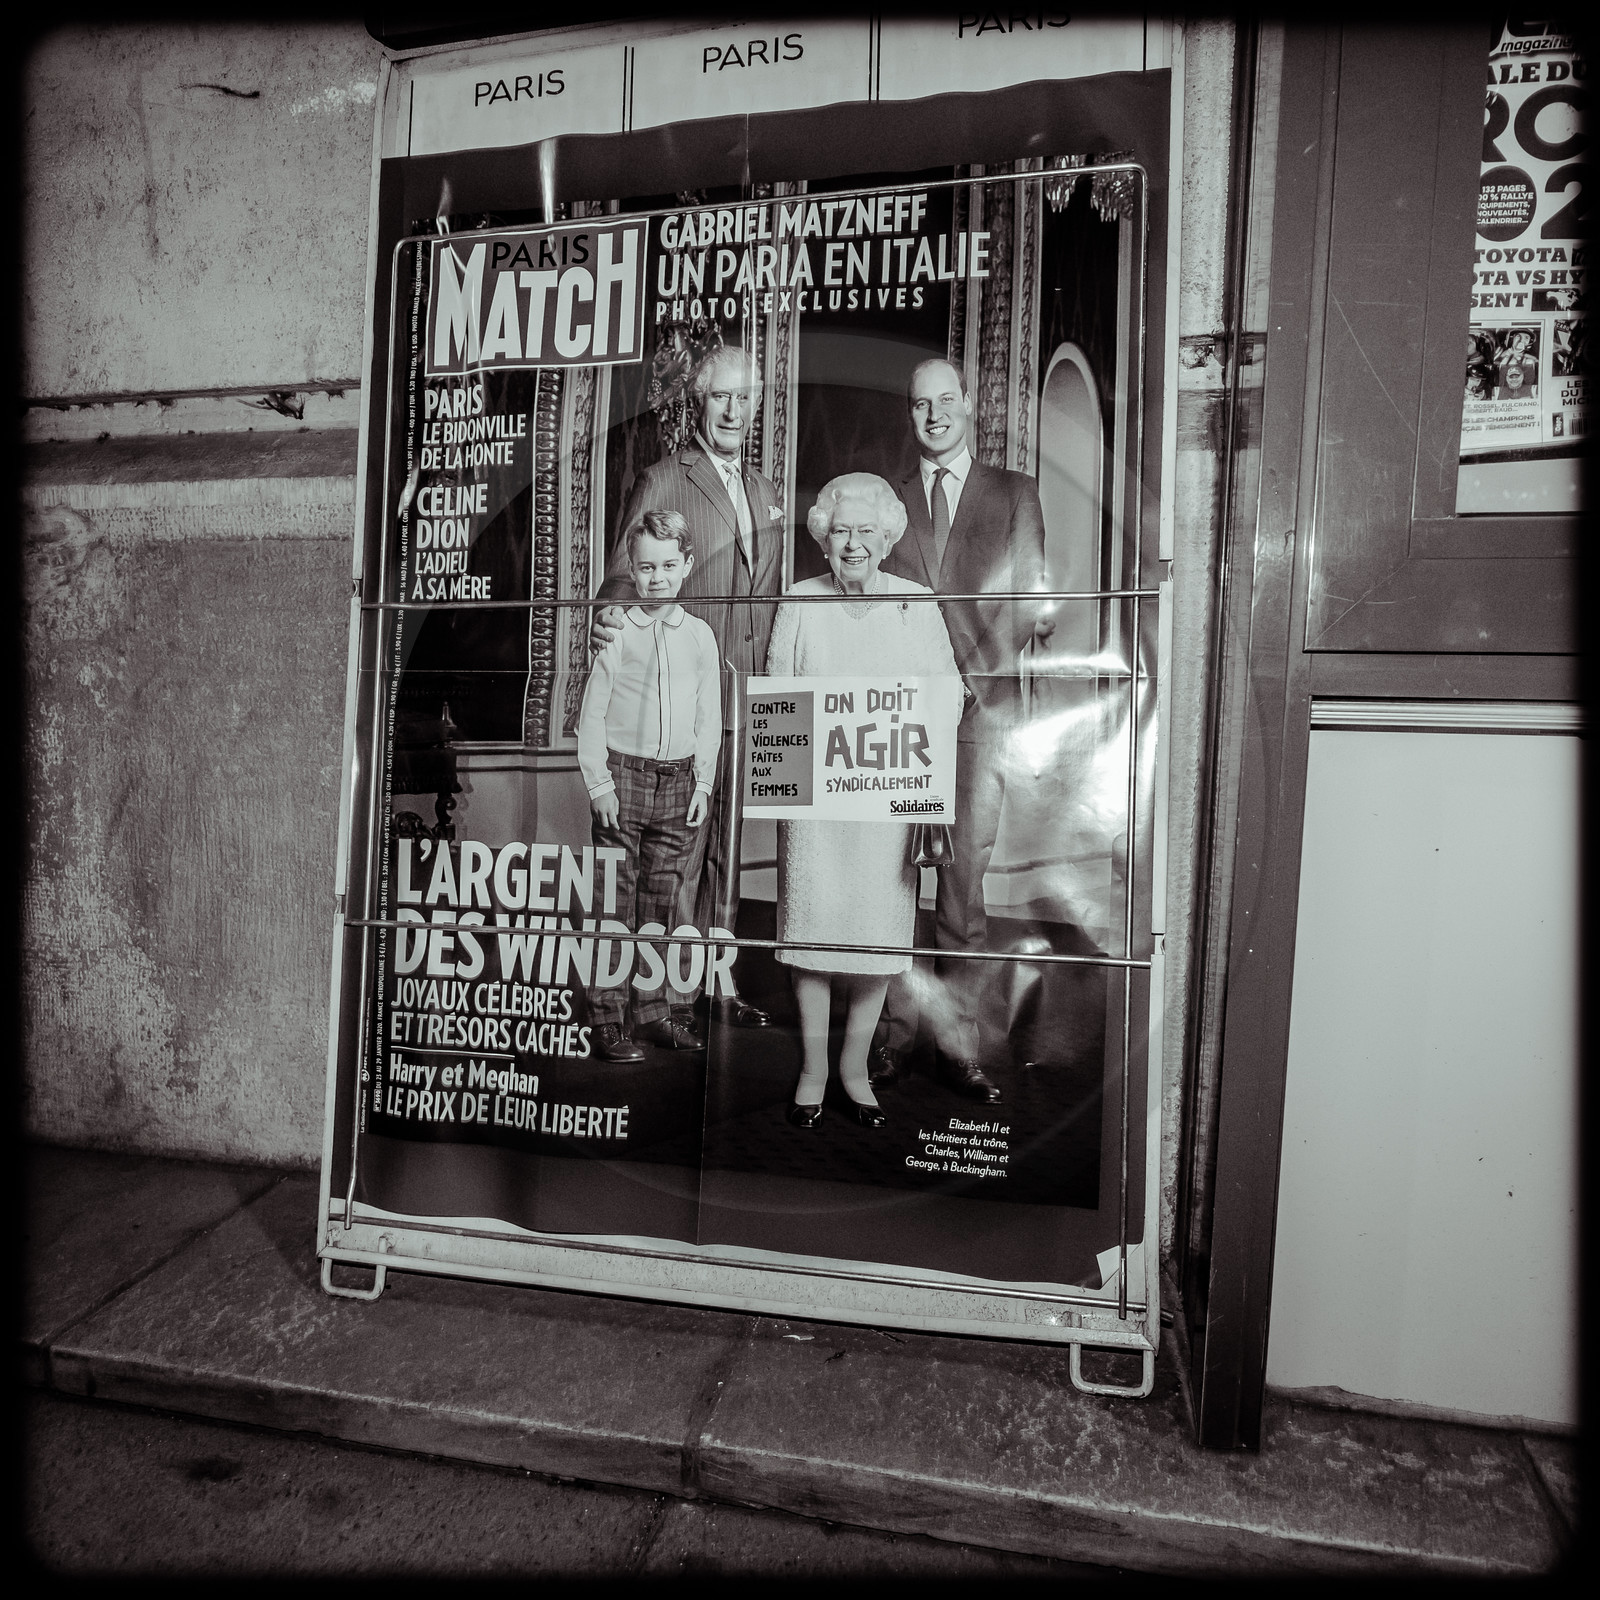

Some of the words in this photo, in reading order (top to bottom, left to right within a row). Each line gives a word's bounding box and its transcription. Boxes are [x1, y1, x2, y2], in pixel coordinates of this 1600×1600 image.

[958, 10, 1072, 39] PARIS
[703, 33, 804, 73] PARIS
[474, 70, 566, 107] PARIS
[1482, 184, 1496, 194] 132
[1497, 184, 1527, 193] PAGES
[1500, 191, 1534, 201] RALLYE
[660, 206, 771, 250] GABRIEL
[778, 193, 928, 242] MATZNEFF
[491, 235, 589, 269] PARIS
[657, 252, 707, 298] UN
[715, 243, 816, 293] PARIA
[825, 239, 871, 285] EN
[881, 231, 991, 283] ITALIE
[1515, 270, 1546, 286] VS
[433, 229, 640, 368] MATCH
[656, 297, 750, 322] PHOTOS
[763, 286, 925, 313] EXCLUSIVES
[424, 384, 483, 419] PARIS
[422, 422, 441, 444] LE
[443, 413, 527, 444] BIDONVILLE
[1487, 414, 1535, 423] CHAMPIONS
[420, 447, 441, 470] DE
[444, 446, 464, 470] LA
[465, 441, 514, 468] HONTE
[416, 483, 488, 517] CÉLINE
[416, 518, 470, 549] DION
[414, 550, 468, 575] L'ADIEU
[411, 574, 424, 600] À
[426, 577, 447, 600] SA
[449, 571, 492, 600] MÈRE
[376, 1065, 382, 1073] AU
[412, 297, 420, 314] RANALD
[751, 701, 796, 715] CONTRE
[824, 691, 854, 714] ON
[752, 719, 768, 729] LES
[751, 732, 809, 748] VIOLENCES
[824, 714, 933, 771] AGIR
[751, 750, 783, 764] FAITES
[751, 766, 772, 777] AUX
[751, 781, 798, 797] FEMMES
[826, 773, 933, 794] SYNDICALEMENT
[890, 800, 945, 815] Solidaires
[397, 838, 627, 915] L'ARGENT
[394, 907, 487, 980] DES
[496, 913, 739, 998] WINDSOR
[390, 977, 471, 1014] JOYAUX
[473, 980, 574, 1022] CÉLÈBRES
[390, 1011, 418, 1043] ET
[416, 1011, 511, 1051] TRÉSORS
[514, 1020, 593, 1059] CACHÉS
[389, 1053, 438, 1087] Harry
[440, 1062, 465, 1085] et
[467, 1060, 540, 1097] Meghan
[386, 1085, 402, 1116] LE
[405, 1088, 457, 1122] PRIX
[460, 1092, 489, 1123] DE
[493, 1092, 538, 1132] LEUR
[541, 1103, 630, 1140] LIBERTÉ
[949, 1118, 990, 1133] Elizabeth
[992, 1122, 999, 1133] II
[1000, 1125, 1010, 1134] et
[918, 1129, 930, 1140] les
[932, 1130, 967, 1145] héritiers
[969, 1135, 981, 1146] du
[983, 1138, 1009, 1149] trône,
[925, 1144, 960, 1159] Charles,
[963, 1148, 997, 1162] William
[999, 1154, 1009, 1163] et
[905, 1155, 941, 1171] George,
[942, 1161, 949, 1171] à
[950, 1161, 1008, 1178] Buckingham.
